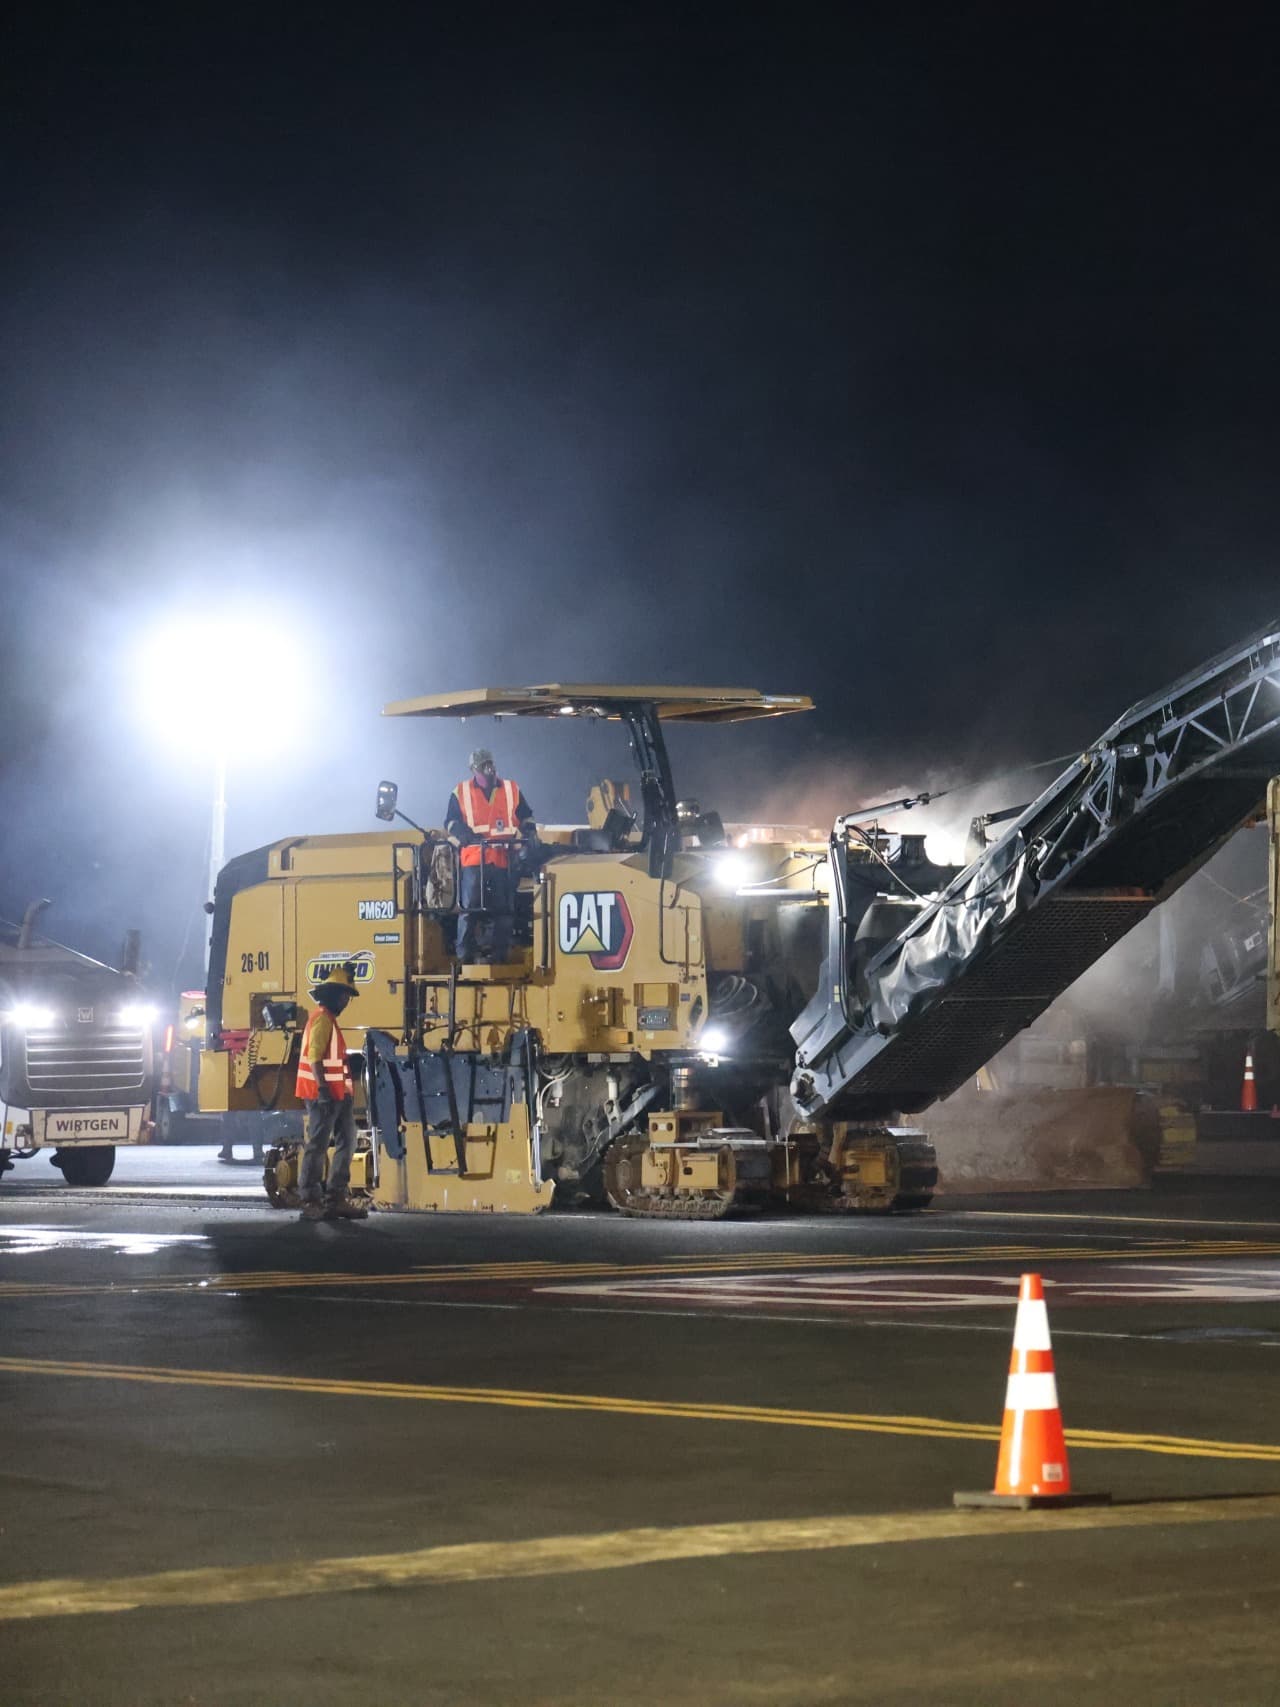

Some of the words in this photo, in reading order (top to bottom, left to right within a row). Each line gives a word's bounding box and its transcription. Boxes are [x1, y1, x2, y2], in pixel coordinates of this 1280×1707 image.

[359, 900, 394, 919] PM620
[560, 893, 615, 952] CAT
[56, 1118, 119, 1132] WIRTGEN
